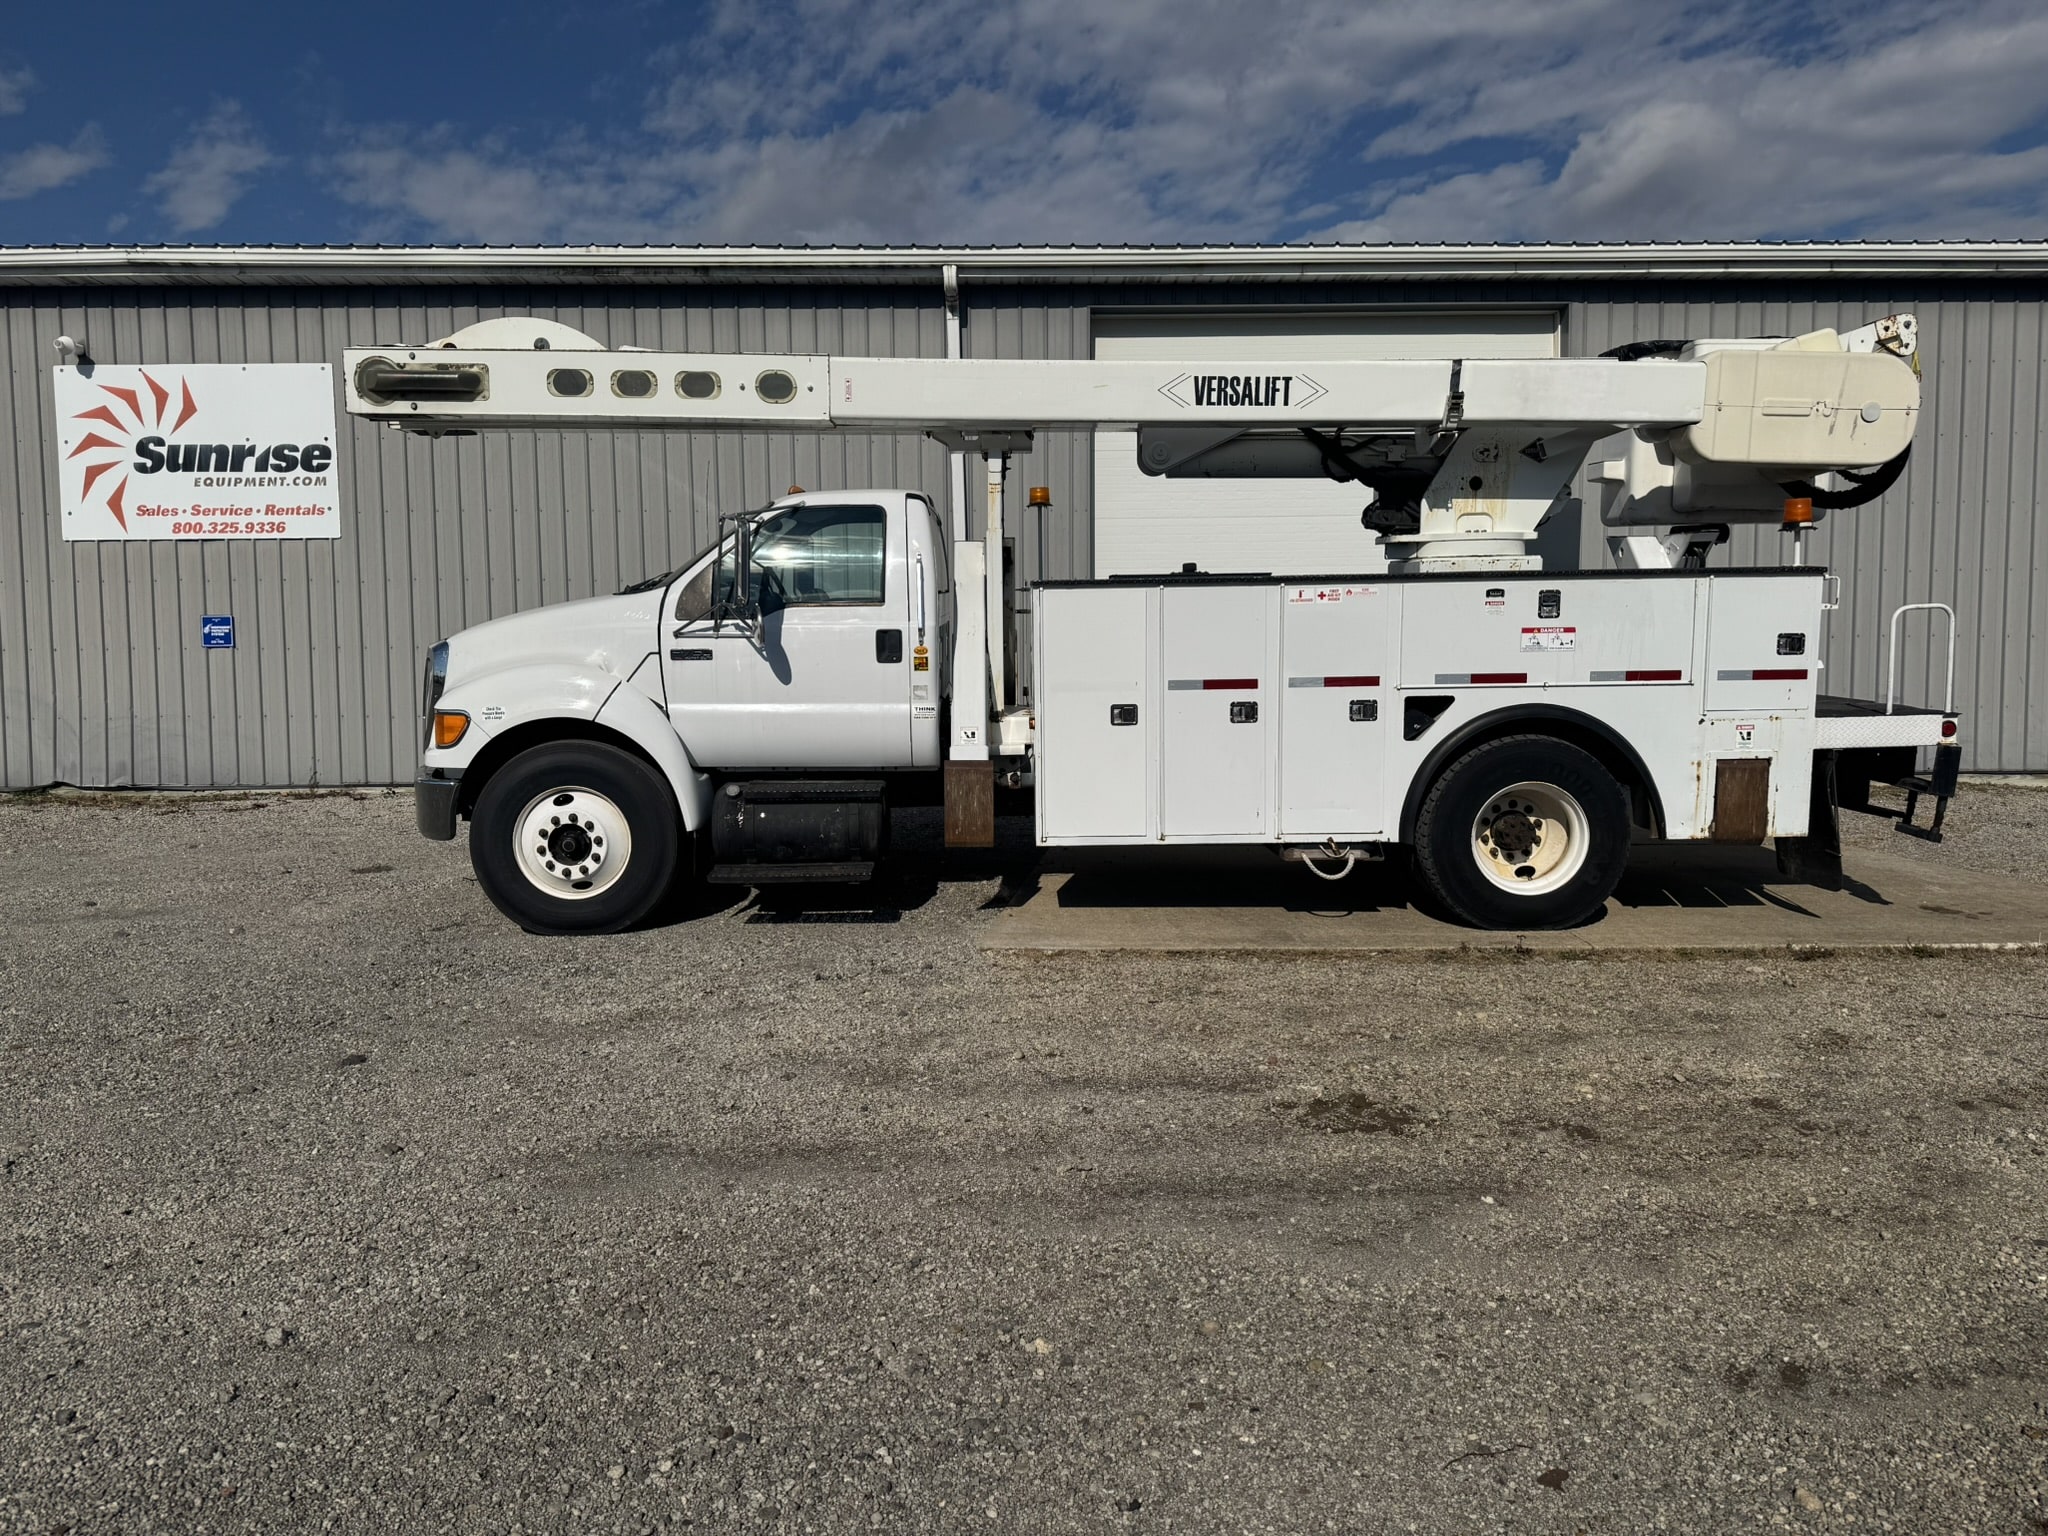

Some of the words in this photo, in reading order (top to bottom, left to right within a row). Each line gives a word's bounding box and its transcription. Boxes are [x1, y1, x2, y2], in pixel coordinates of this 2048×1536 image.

[1193, 375, 1293, 407] VERSALIFT
[133, 435, 332, 474] Sunrise
[193, 476, 327, 487] EQUIPMENT.COM
[135, 504, 179, 517] Sales
[190, 503, 253, 517] Service
[264, 503, 326, 517] Rentals
[171, 521, 287, 535] 800.325.9336
